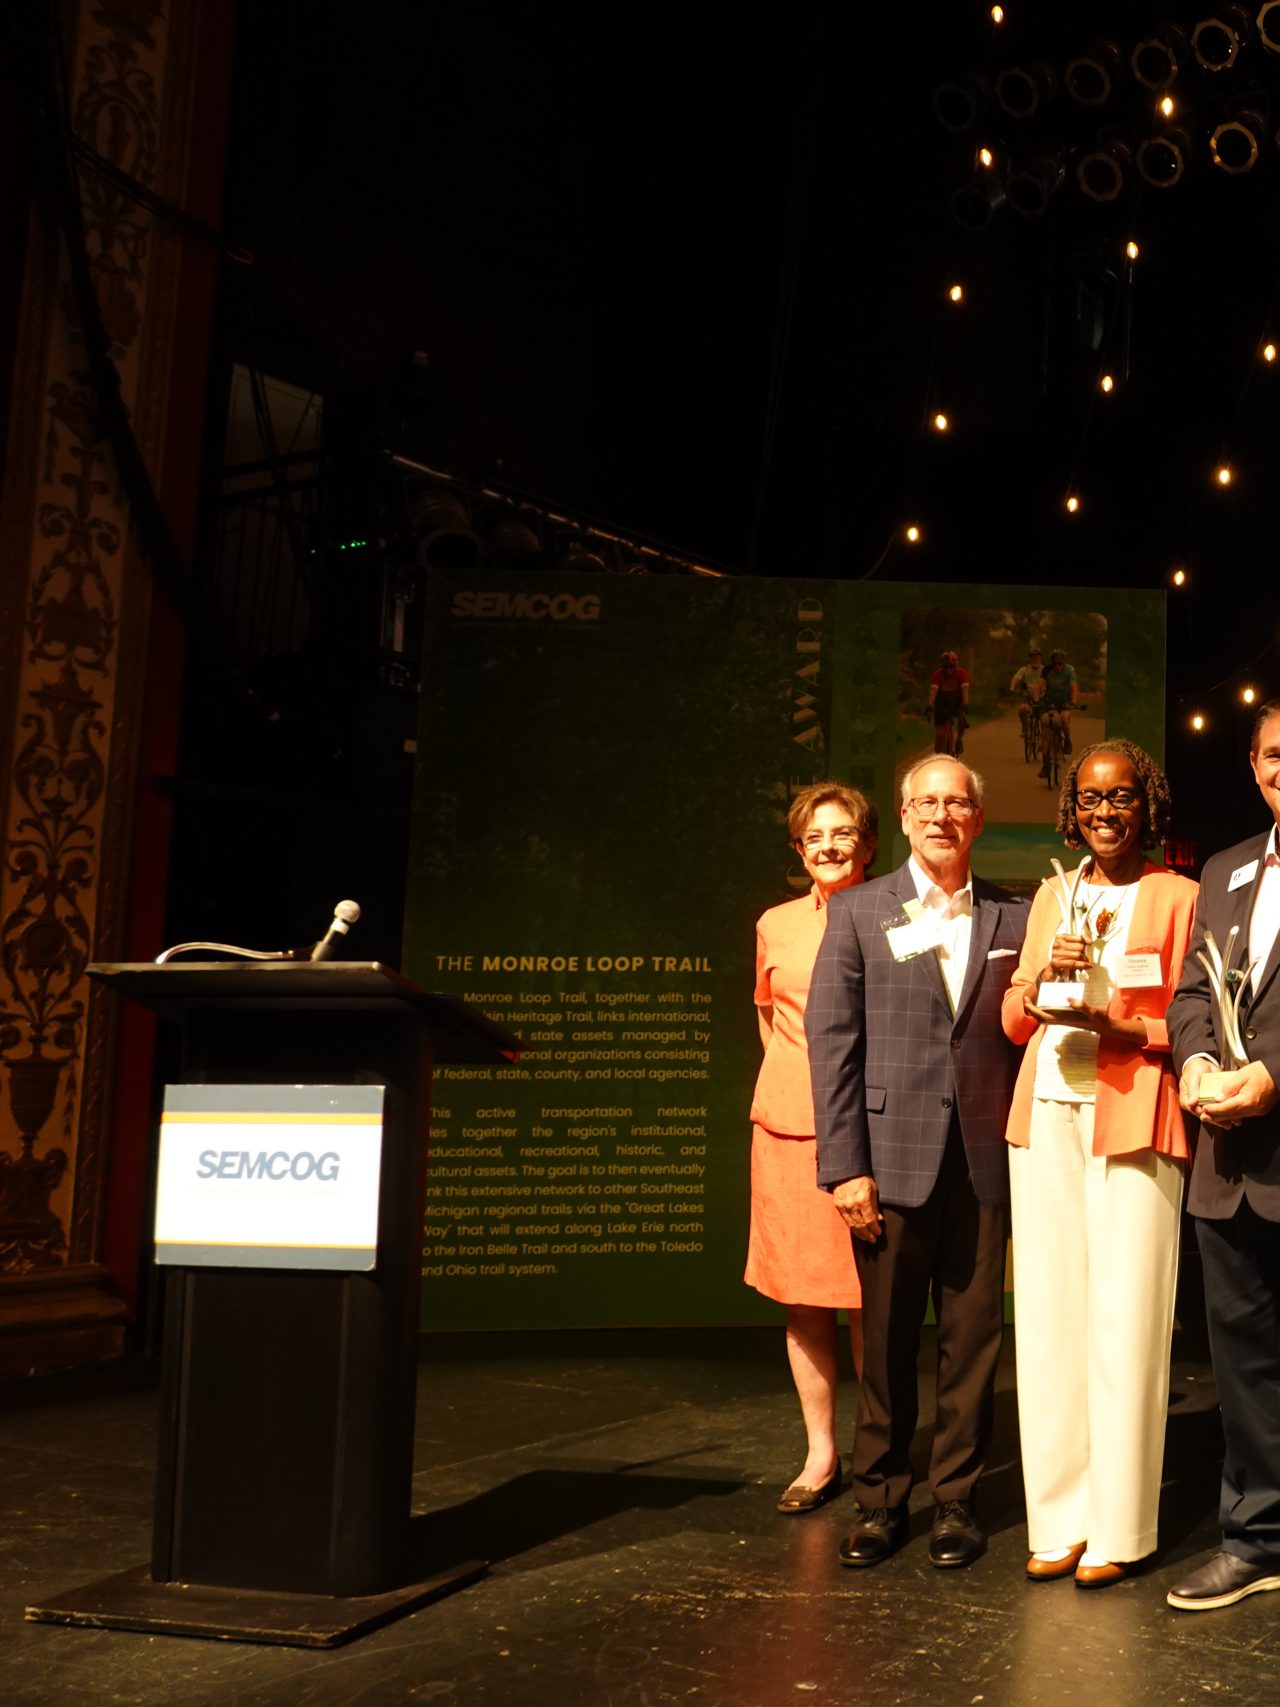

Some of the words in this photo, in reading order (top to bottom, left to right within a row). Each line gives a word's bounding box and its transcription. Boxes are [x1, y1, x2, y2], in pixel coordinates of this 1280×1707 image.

[450, 591, 602, 620] SEMCOG
[791, 597, 823, 752] AWARD
[436, 956, 474, 972] THE
[482, 956, 579, 973] MONROE
[586, 956, 644, 973] LOOP
[651, 956, 712, 973] TRAIL
[464, 992, 513, 1004] Monroe
[520, 992, 551, 1006] Loop
[559, 992, 587, 1004] Trail,
[595, 992, 651, 1007] together
[657, 992, 684, 1004] with
[692, 992, 712, 1004] the
[507, 1011, 562, 1026] Heritage
[566, 1011, 594, 1023] Trail,
[597, 1011, 625, 1022] links
[628, 1011, 711, 1024] international,
[531, 1031, 563, 1042] state
[572, 1031, 613, 1042] assets
[622, 1030, 686, 1045] managed
[695, 1030, 710, 1044] by
[555, 1049, 641, 1064] organizations
[644, 1049, 710, 1064] consisting
[444, 1068, 493, 1081] federal,
[496, 1069, 531, 1081] state,
[535, 1069, 582, 1083] county,
[585, 1068, 611, 1080] and
[614, 1068, 646, 1080] local
[648, 1068, 710, 1083] agencies.
[476, 1107, 516, 1119] active
[541, 1106, 632, 1121] transportation
[657, 1106, 707, 1118] network
[429, 1126, 447, 1139] ies
[462, 1126, 518, 1141] together
[532, 1126, 553, 1138] the
[631, 1125, 706, 1137] institutional,
[520, 1145, 599, 1157] recreational,
[616, 1144, 664, 1157] historic,
[680, 1144, 706, 1156] and
[196, 1149, 341, 1181] SEMCOG
[473, 1166, 518, 1177] assets.
[522, 1165, 545, 1177] The
[547, 1165, 576, 1180] goal
[579, 1164, 589, 1176] is
[592, 1165, 606, 1176] to
[608, 1164, 637, 1176] then
[640, 1163, 705, 1178] eventually
[445, 1185, 468, 1197] this
[471, 1185, 531, 1197] extensive
[534, 1184, 585, 1196] network
[588, 1185, 602, 1195] to
[604, 1184, 637, 1195] other
[641, 1183, 704, 1195] Southeast
[484, 1204, 537, 1220] regional
[541, 1203, 572, 1216] trails
[577, 1204, 596, 1215] via
[600, 1203, 621, 1215] the
[669, 1203, 704, 1214] Lakes
[457, 1225, 483, 1236] that
[490, 1224, 509, 1236] will
[515, 1224, 559, 1236] extend
[565, 1223, 602, 1238] along
[608, 1222, 637, 1234] Lake
[642, 1221, 664, 1233] Erie
[670, 1222, 703, 1233] north
[422, 1247, 432, 1257] o
[434, 1245, 456, 1257] the
[459, 1245, 483, 1256] Iron
[487, 1244, 518, 1256] Belle
[521, 1243, 548, 1255] Trail
[551, 1243, 577, 1255] and
[580, 1242, 616, 1254] south
[620, 1242, 633, 1253] to
[636, 1241, 657, 1253] the
[661, 1241, 703, 1253] Toledo
[446, 1264, 477, 1277] Ohio
[480, 1264, 505, 1276] trail
[508, 1264, 558, 1278] system.
